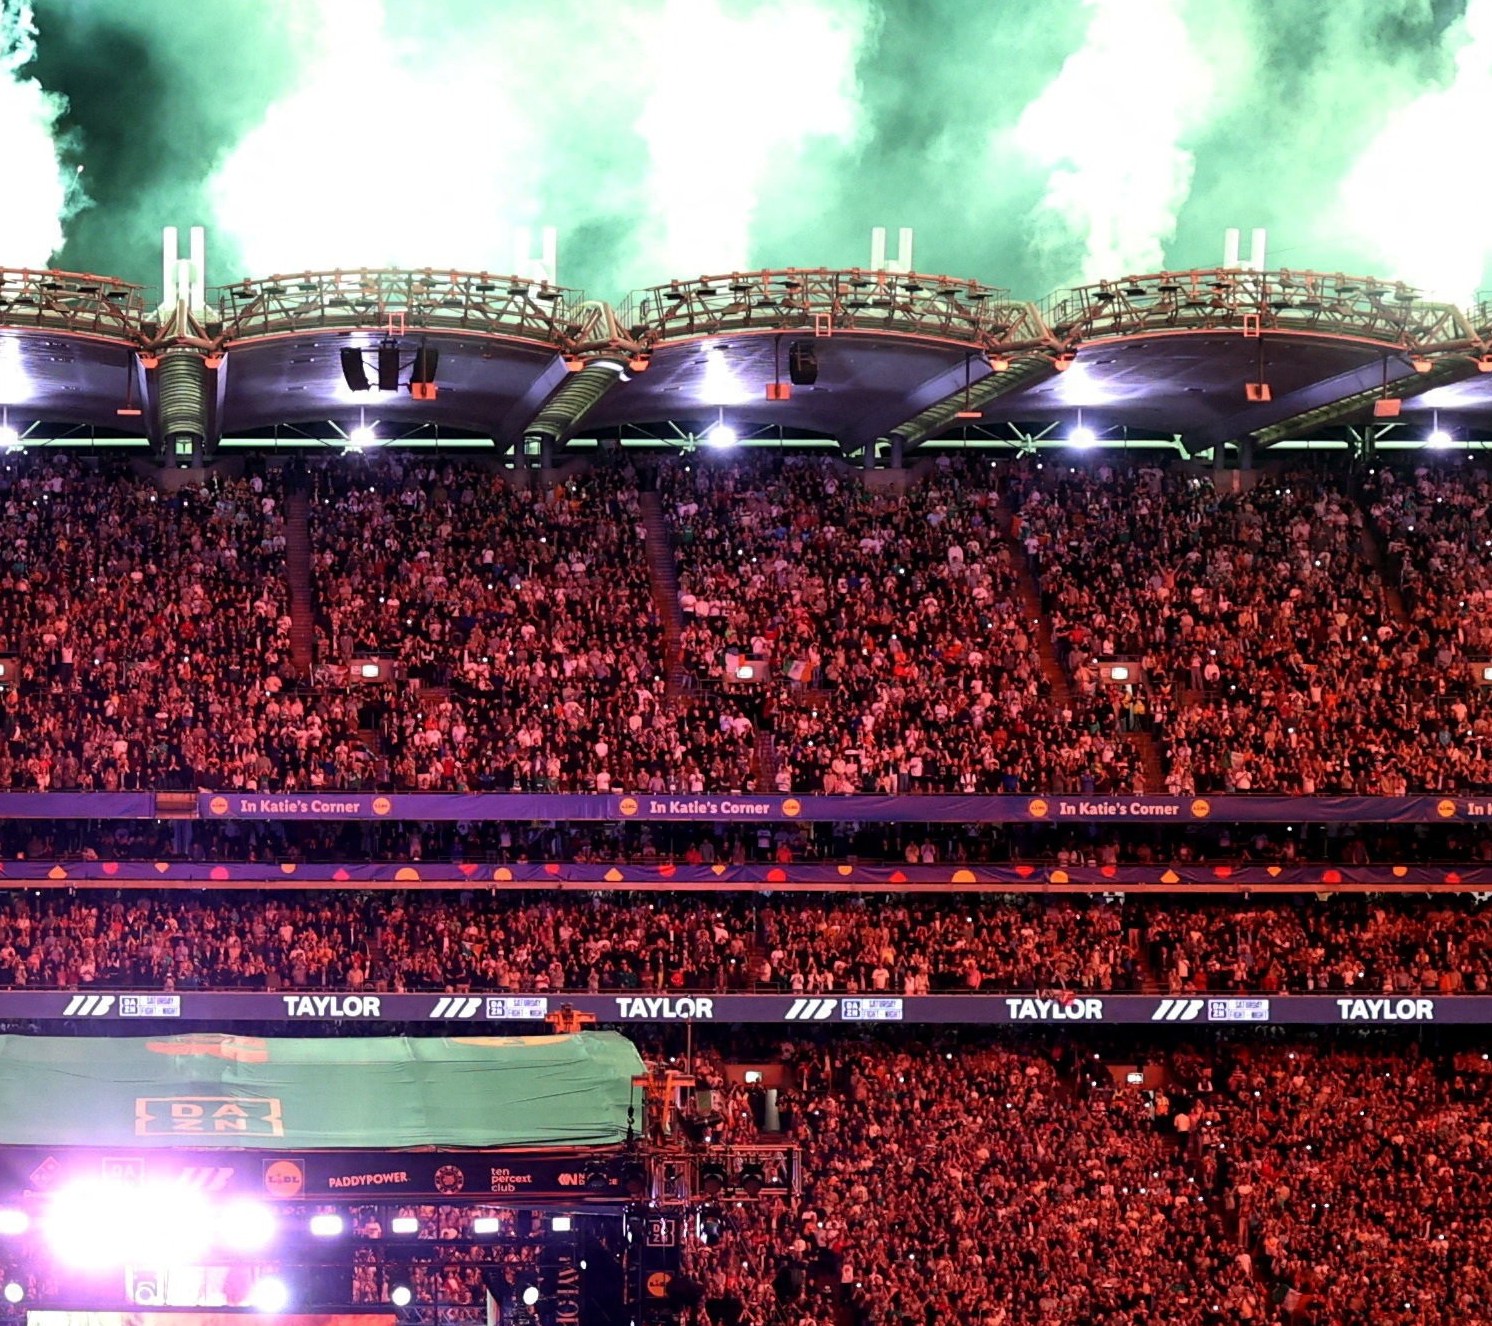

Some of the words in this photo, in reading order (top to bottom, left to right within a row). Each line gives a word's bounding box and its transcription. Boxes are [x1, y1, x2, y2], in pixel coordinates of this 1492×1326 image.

[241, 800, 256, 812] In
[261, 799, 307, 812] Katie's
[311, 800, 360, 812] Corner
[650, 801, 666, 813] In
[670, 801, 717, 813] Katie's
[721, 802, 769, 813] Corner
[1060, 803, 1075, 814] In
[1080, 802, 1127, 815] Katie's
[1130, 803, 1179, 815] Corner
[1468, 803, 1483, 815] In
[284, 996, 380, 1016] TAYLOR
[616, 996, 712, 1017] TAYLOR
[1006, 999, 1102, 1019] TAYLOR
[1337, 999, 1433, 1019] TAYLOR
[171, 1103, 248, 1117] DA
[171, 1118, 247, 1131] ZN
[491, 1184, 515, 1192] club
